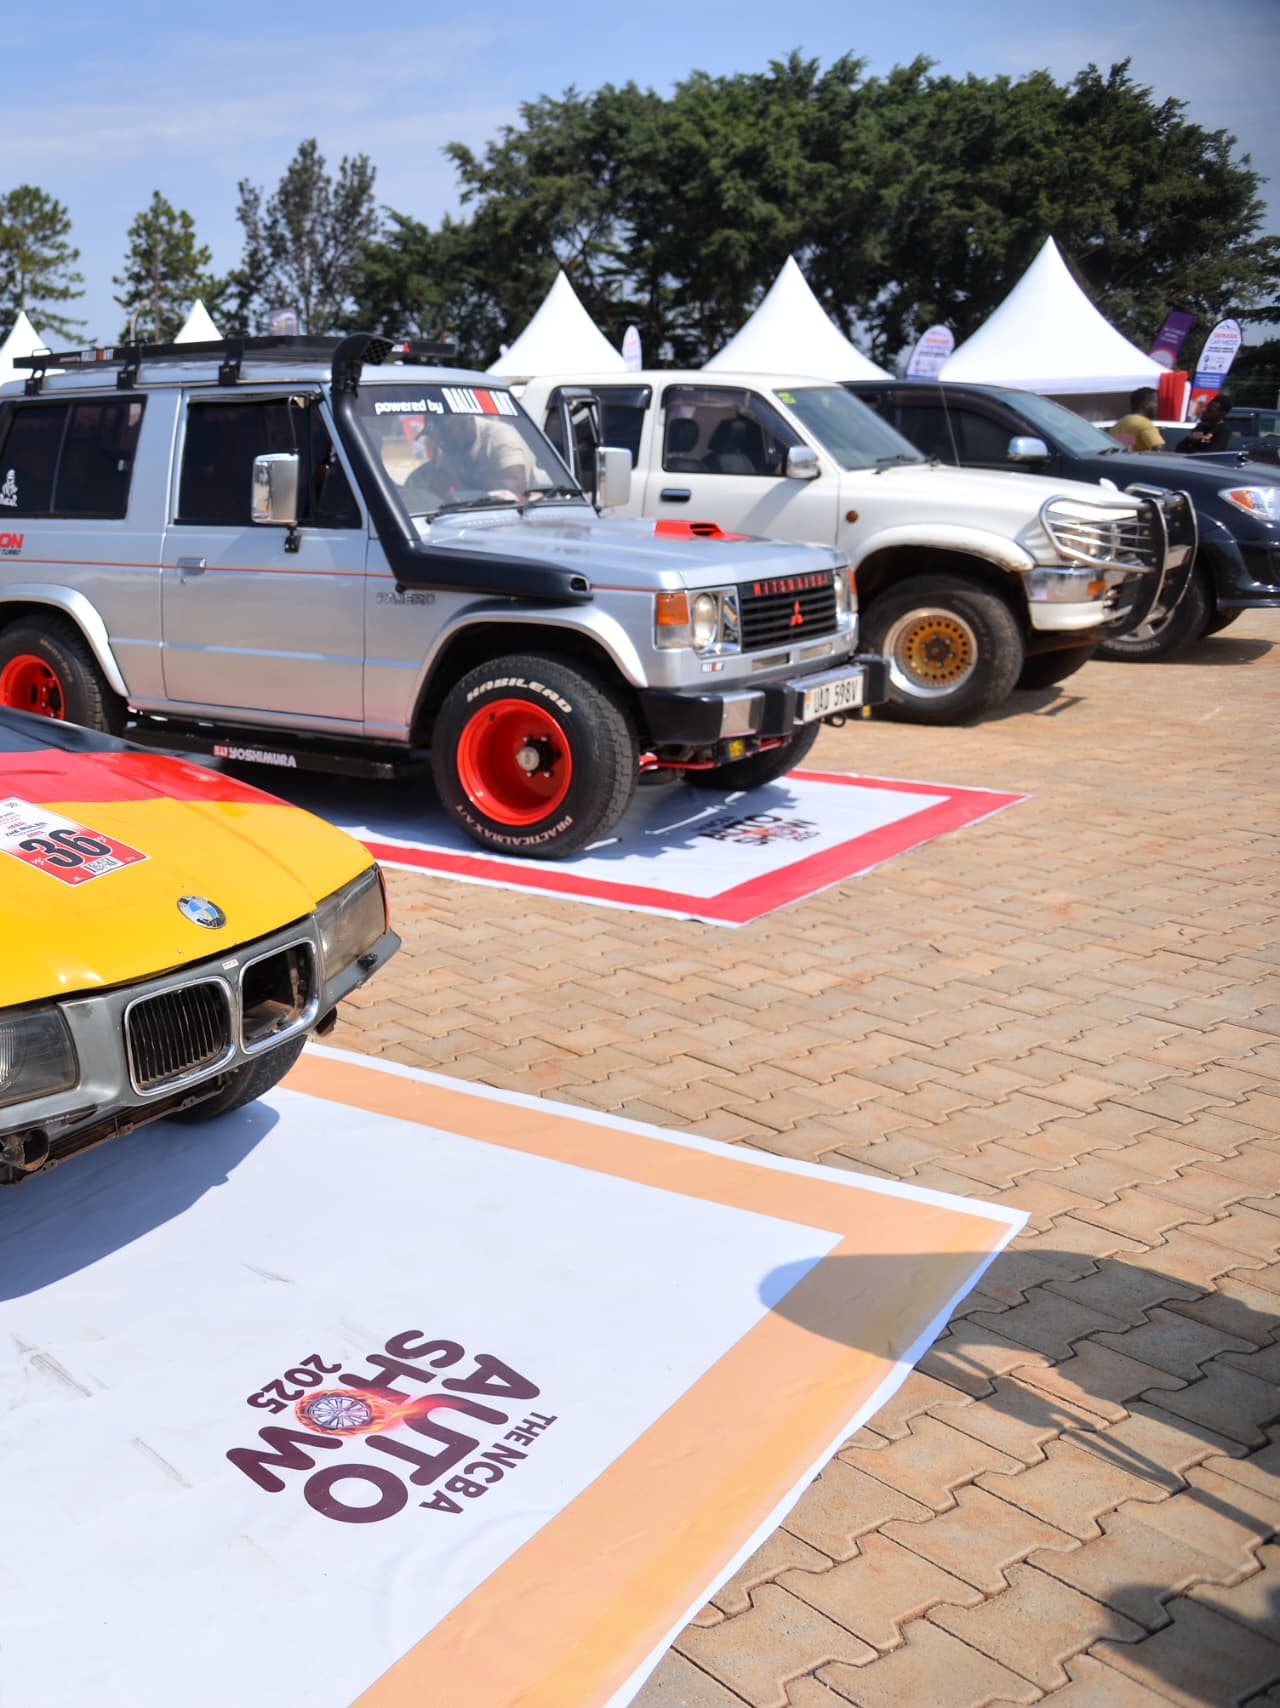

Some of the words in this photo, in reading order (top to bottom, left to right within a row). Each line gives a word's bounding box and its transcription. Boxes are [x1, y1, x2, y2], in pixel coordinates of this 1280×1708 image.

[375, 399, 426, 415] powered
[427, 399, 444, 414] by
[753, 573, 829, 596] MITSUBISHI
[229, 747, 297, 768] YOSHIMURA
[19, 829, 112, 868] 36
[246, 1353, 342, 1415] 2025
[303, 1353, 541, 1523] AUTO
[503, 1411, 558, 1447] THE
[418, 1443, 530, 1515] NCBA
